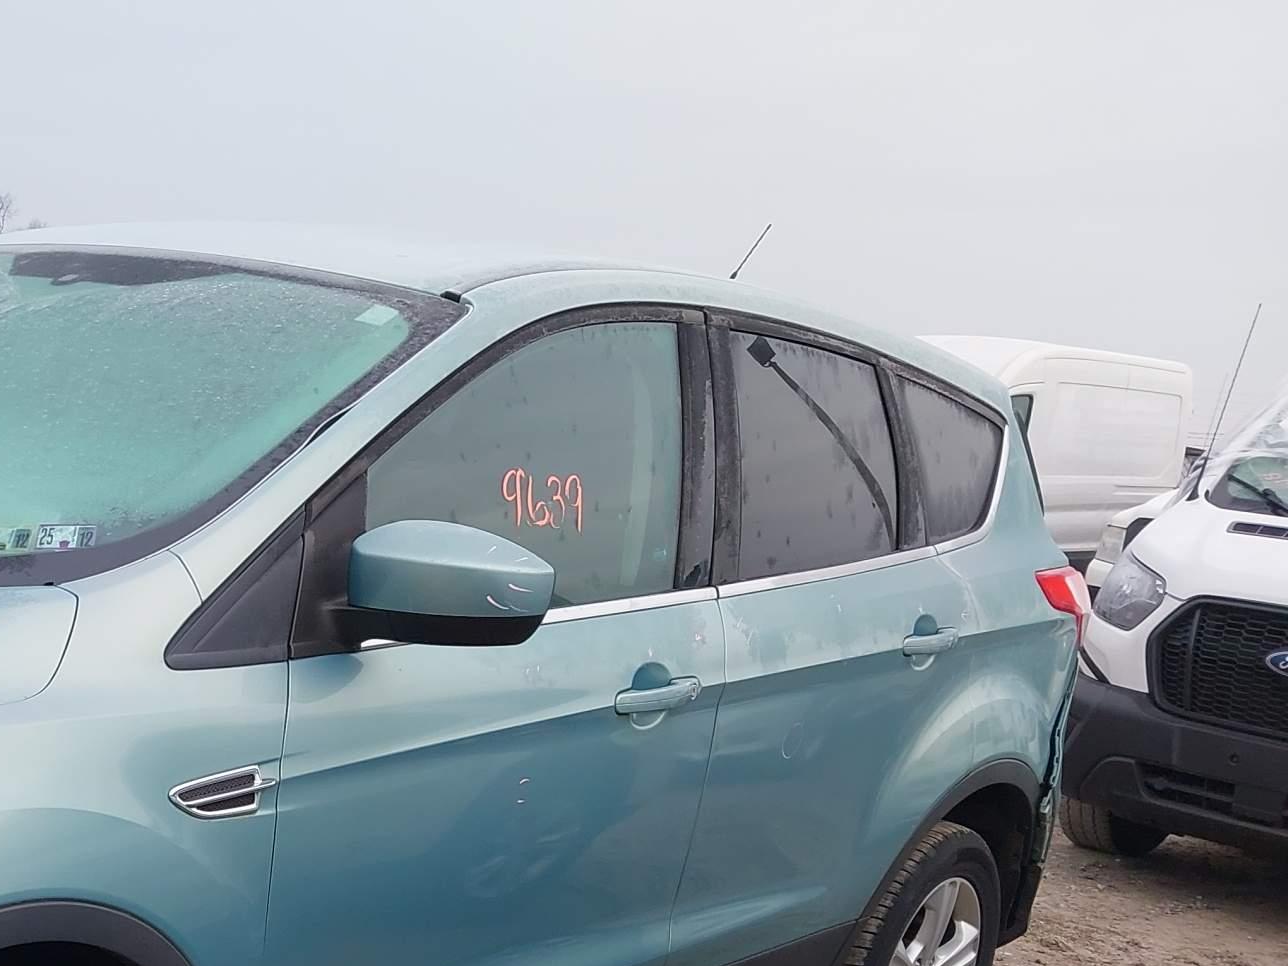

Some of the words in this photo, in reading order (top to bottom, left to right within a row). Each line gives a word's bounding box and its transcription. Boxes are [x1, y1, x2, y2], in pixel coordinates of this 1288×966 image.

[502, 467, 582, 533] 9639
[39, 527, 55, 546] 25
[79, 531, 94, 547] 12
